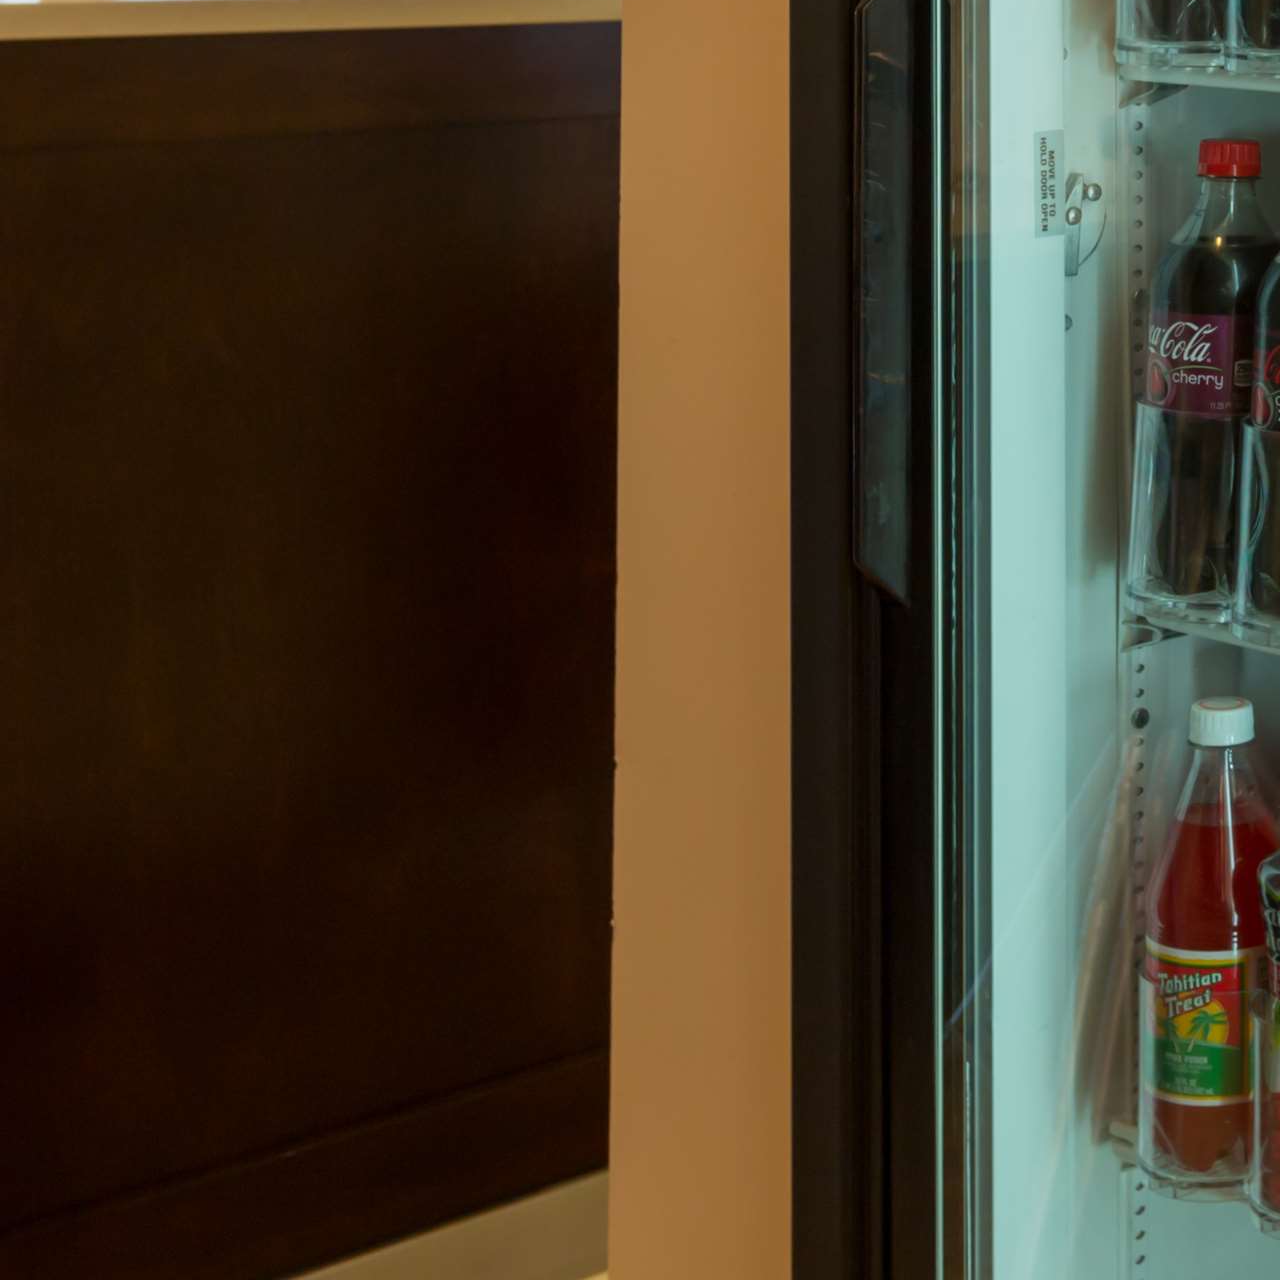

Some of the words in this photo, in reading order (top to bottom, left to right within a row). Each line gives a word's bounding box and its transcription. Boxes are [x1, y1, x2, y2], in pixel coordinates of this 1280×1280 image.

[1039, 136, 1048, 167] HOLD
[1048, 150, 1056, 180] MOVE
[1040, 170, 1049, 200] DOOR
[1048, 184, 1056, 200] UP
[1040, 202, 1049, 233] OPEN
[1048, 203, 1057, 218] TO
[1171, 370, 1224, 391] cherry
[1157, 971, 1223, 994] Tahitian
[1165, 988, 1215, 1018] Treat
